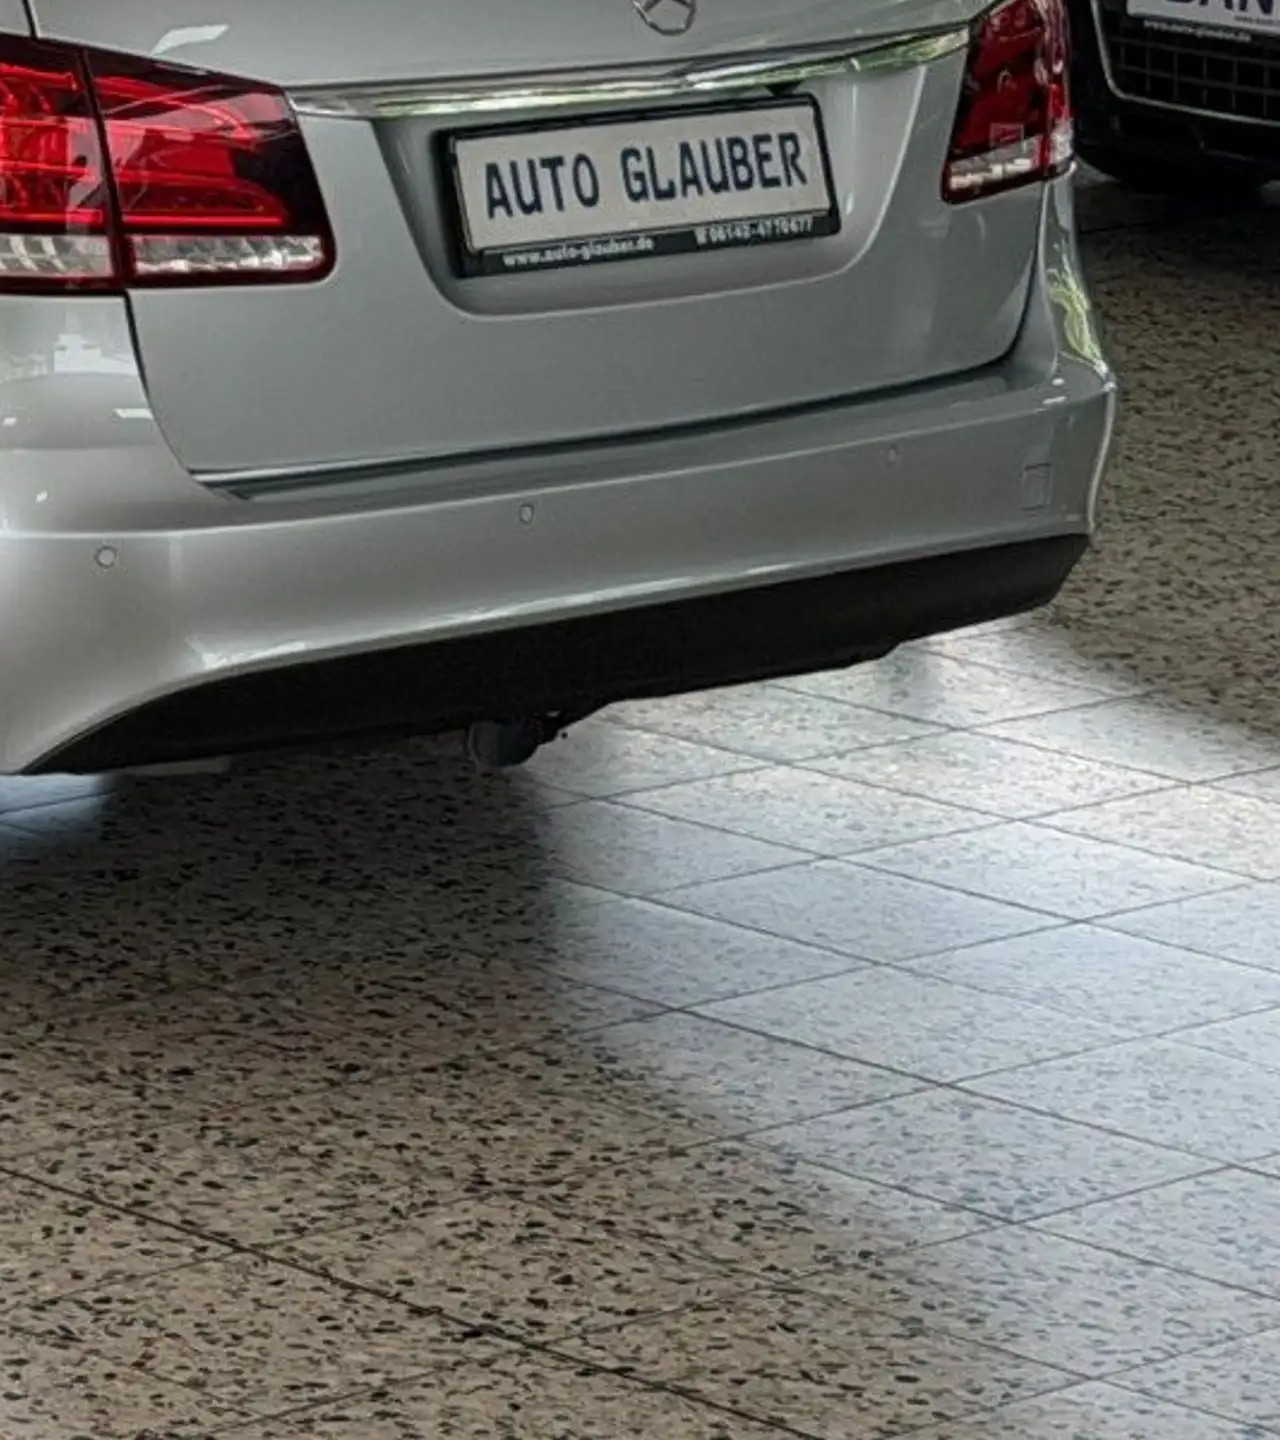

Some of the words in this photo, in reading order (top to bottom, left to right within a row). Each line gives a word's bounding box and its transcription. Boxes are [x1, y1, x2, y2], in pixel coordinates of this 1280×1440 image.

[484, 153, 600, 220] AUTO
[619, 131, 808, 203] GLAUBER
[501, 234, 655, 268] www.auto-glauber.de
